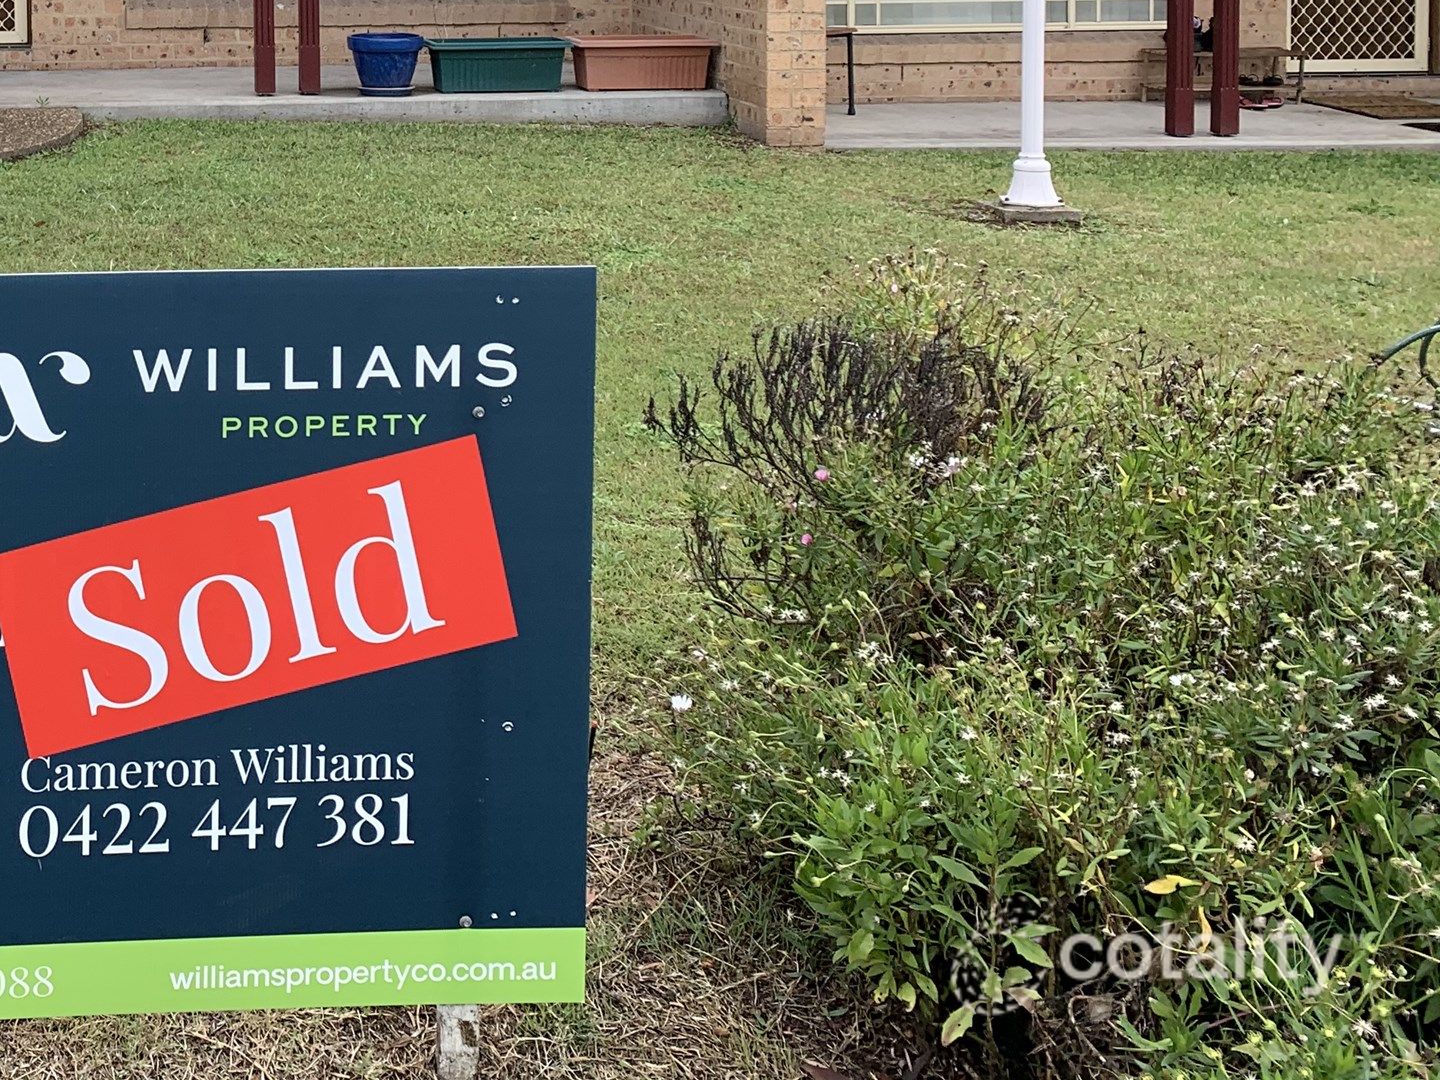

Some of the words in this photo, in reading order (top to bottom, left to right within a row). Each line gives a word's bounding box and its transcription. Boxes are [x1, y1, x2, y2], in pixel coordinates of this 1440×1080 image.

[133, 343, 518, 393] WILLIAMS
[222, 414, 427, 439] PROPERTY
[68, 481, 445, 716] Sold
[21, 757, 219, 793] Cameron
[231, 744, 415, 785] Williams
[18, 802, 170, 858] 0422
[192, 797, 297, 851] 447
[316, 794, 415, 847] 381
[169, 959, 557, 996] williamspropertyco.com.au
